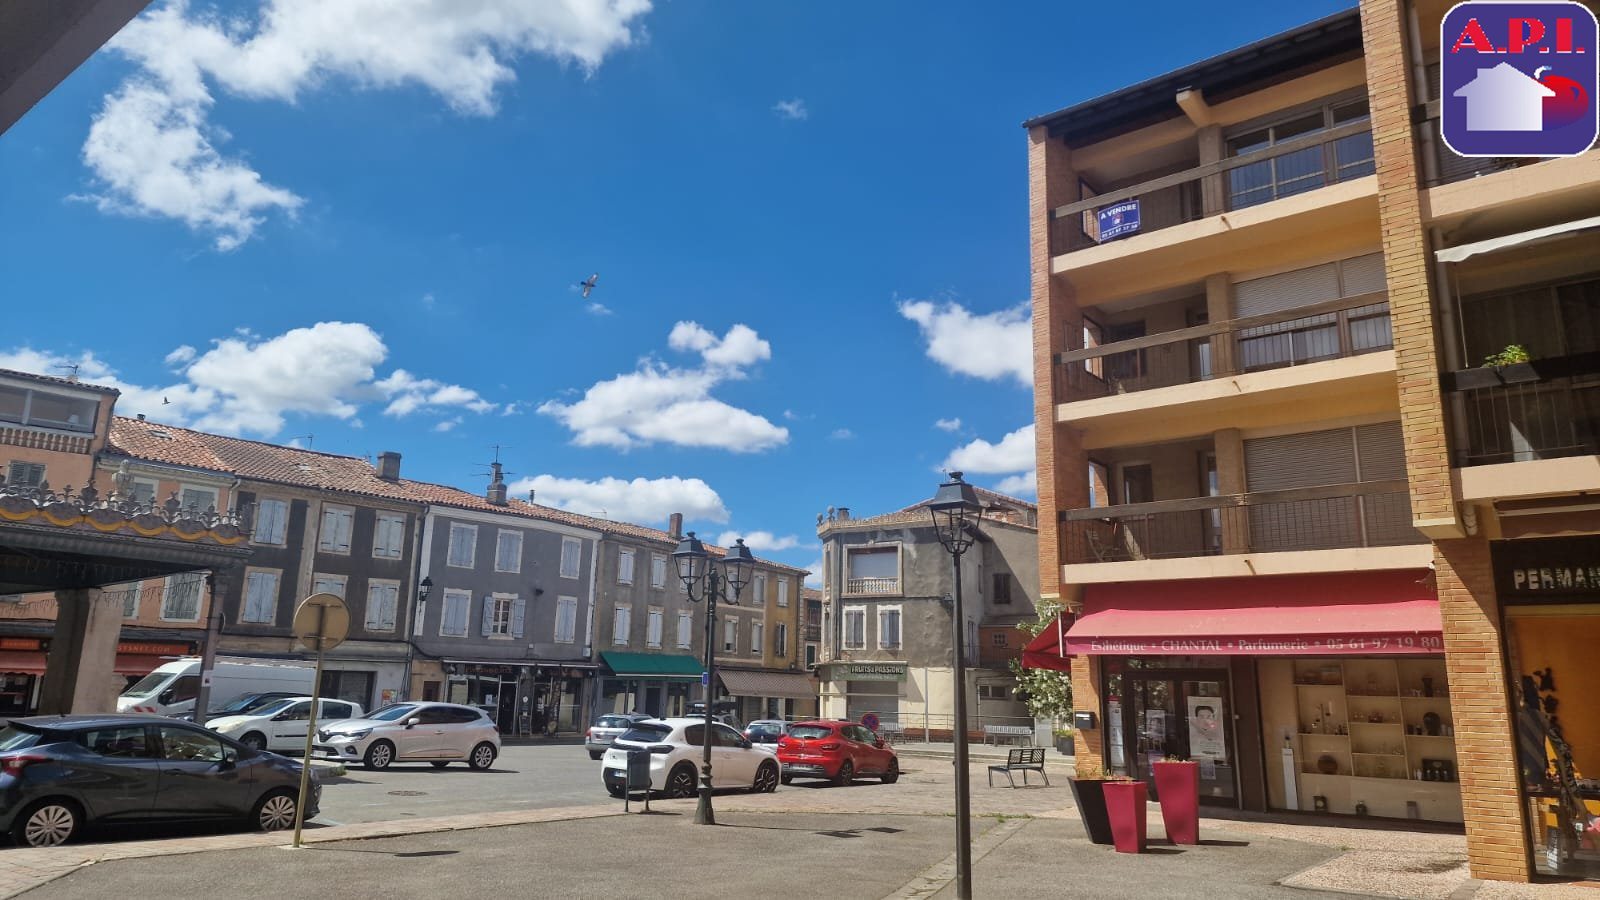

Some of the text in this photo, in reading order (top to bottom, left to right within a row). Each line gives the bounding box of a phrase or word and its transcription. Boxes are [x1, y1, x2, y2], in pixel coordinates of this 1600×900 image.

[1106, 203, 1137, 217] VENDRE
[1091, 635, 1440, 653] Esthétique CHANTAL Parfumerie 05 61 97 19 80
